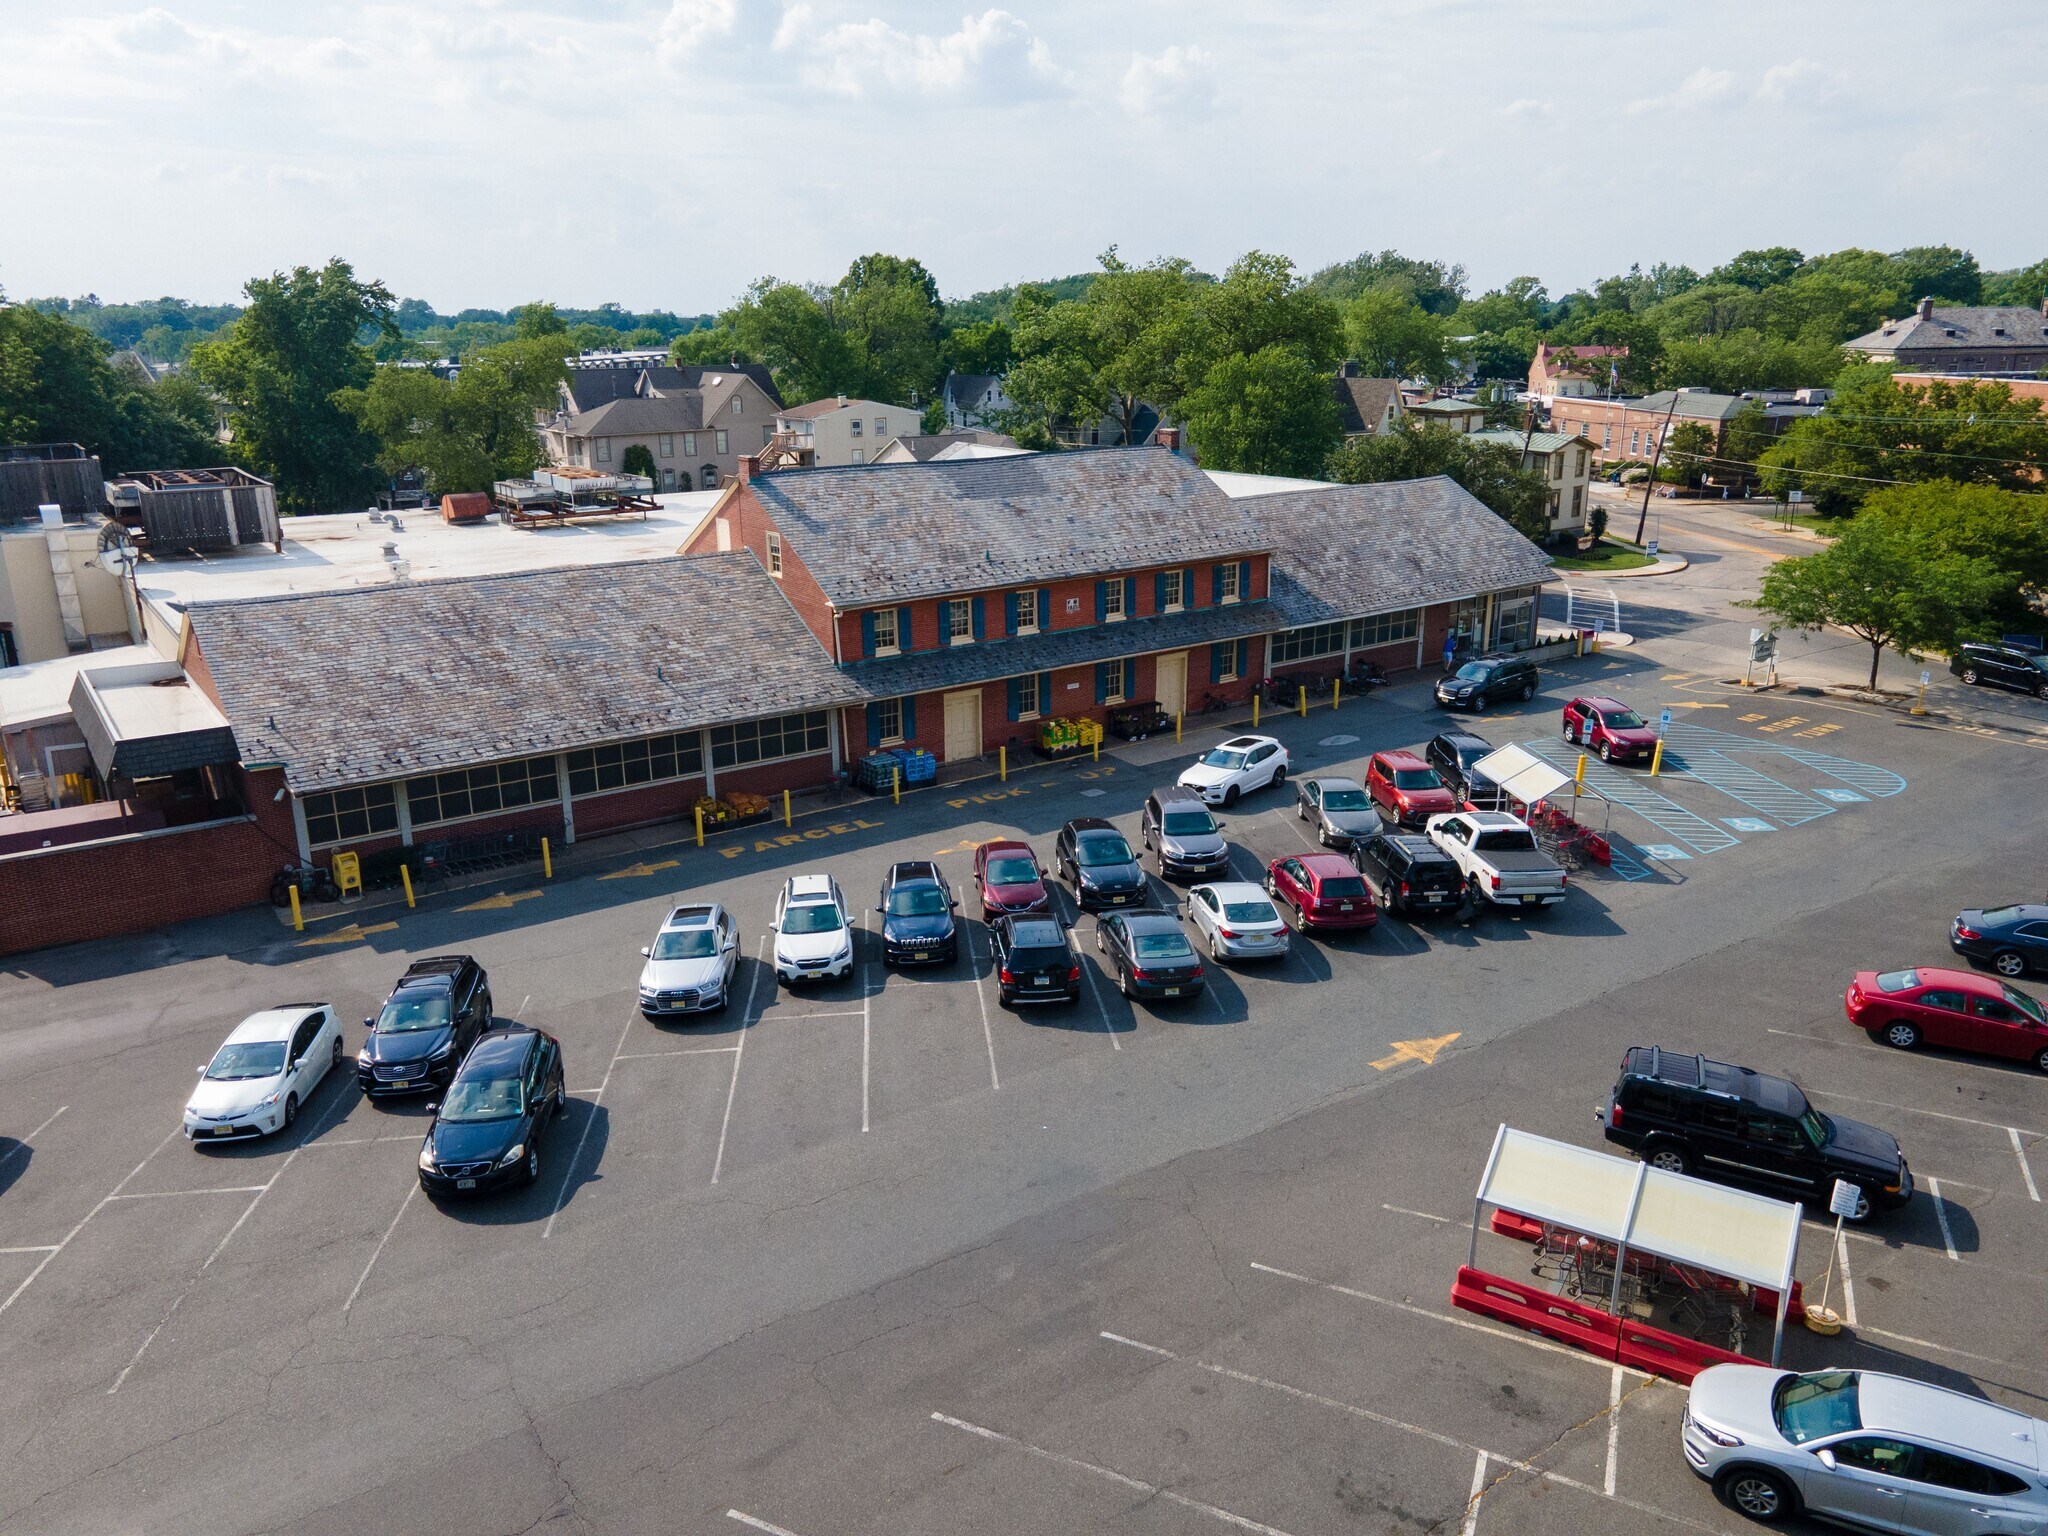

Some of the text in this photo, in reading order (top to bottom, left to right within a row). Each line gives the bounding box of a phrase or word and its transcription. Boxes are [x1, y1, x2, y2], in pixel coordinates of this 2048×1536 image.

[1736, 713, 1768, 723] NO
[1756, 716, 1810, 733] RIGHT
[1792, 723, 1844, 739] TURN
[718, 819, 885, 859] PARCEL
[946, 787, 1031, 809] PICK
